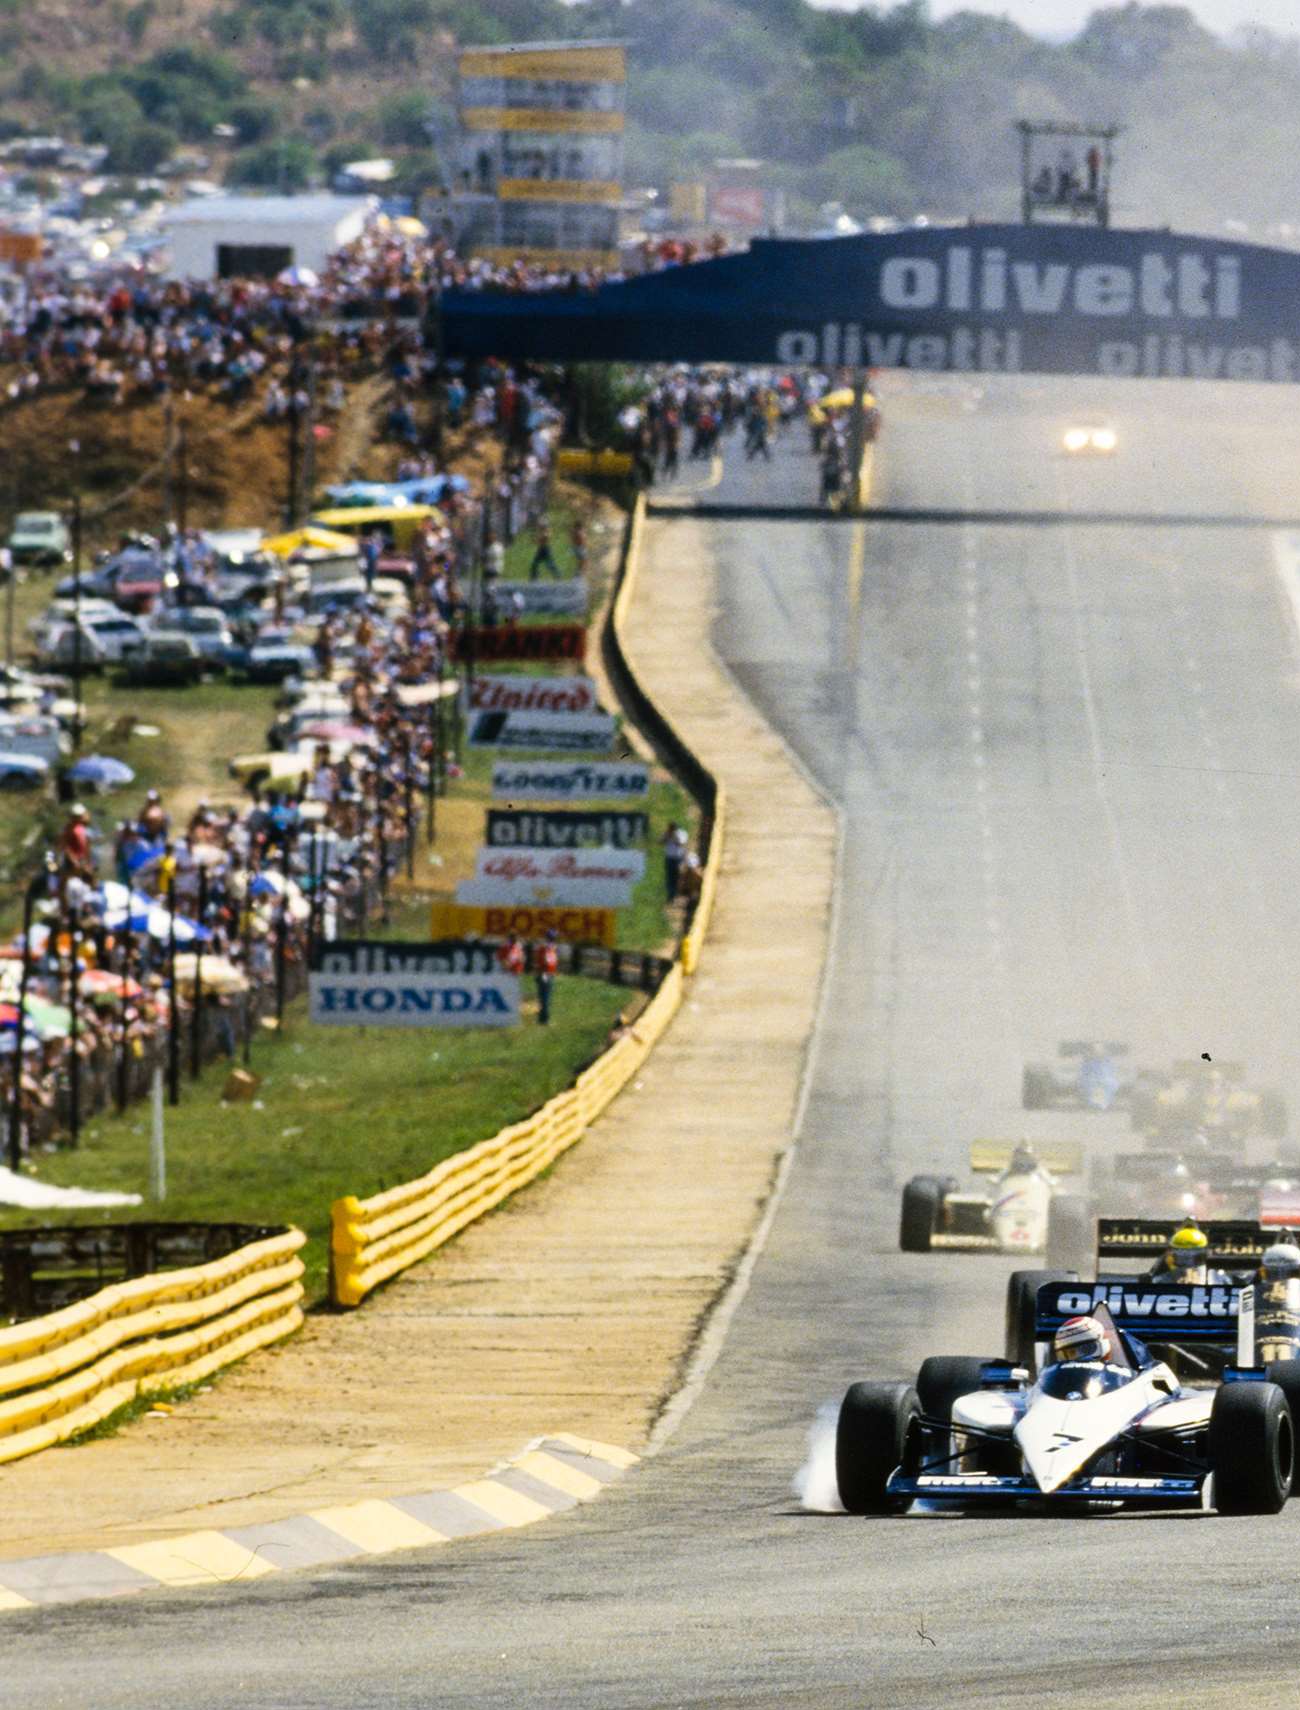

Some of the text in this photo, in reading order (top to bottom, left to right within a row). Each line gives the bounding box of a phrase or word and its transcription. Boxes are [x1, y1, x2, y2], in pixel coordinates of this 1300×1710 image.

[879, 247, 1242, 319] olivetti
[776, 322, 1023, 372] olivetti
[486, 909, 606, 938] BOSCH
[320, 987, 509, 1012] HONDA
[1056, 1285, 1239, 1318] olivetti
[1045, 1433, 1084, 1452] 7
